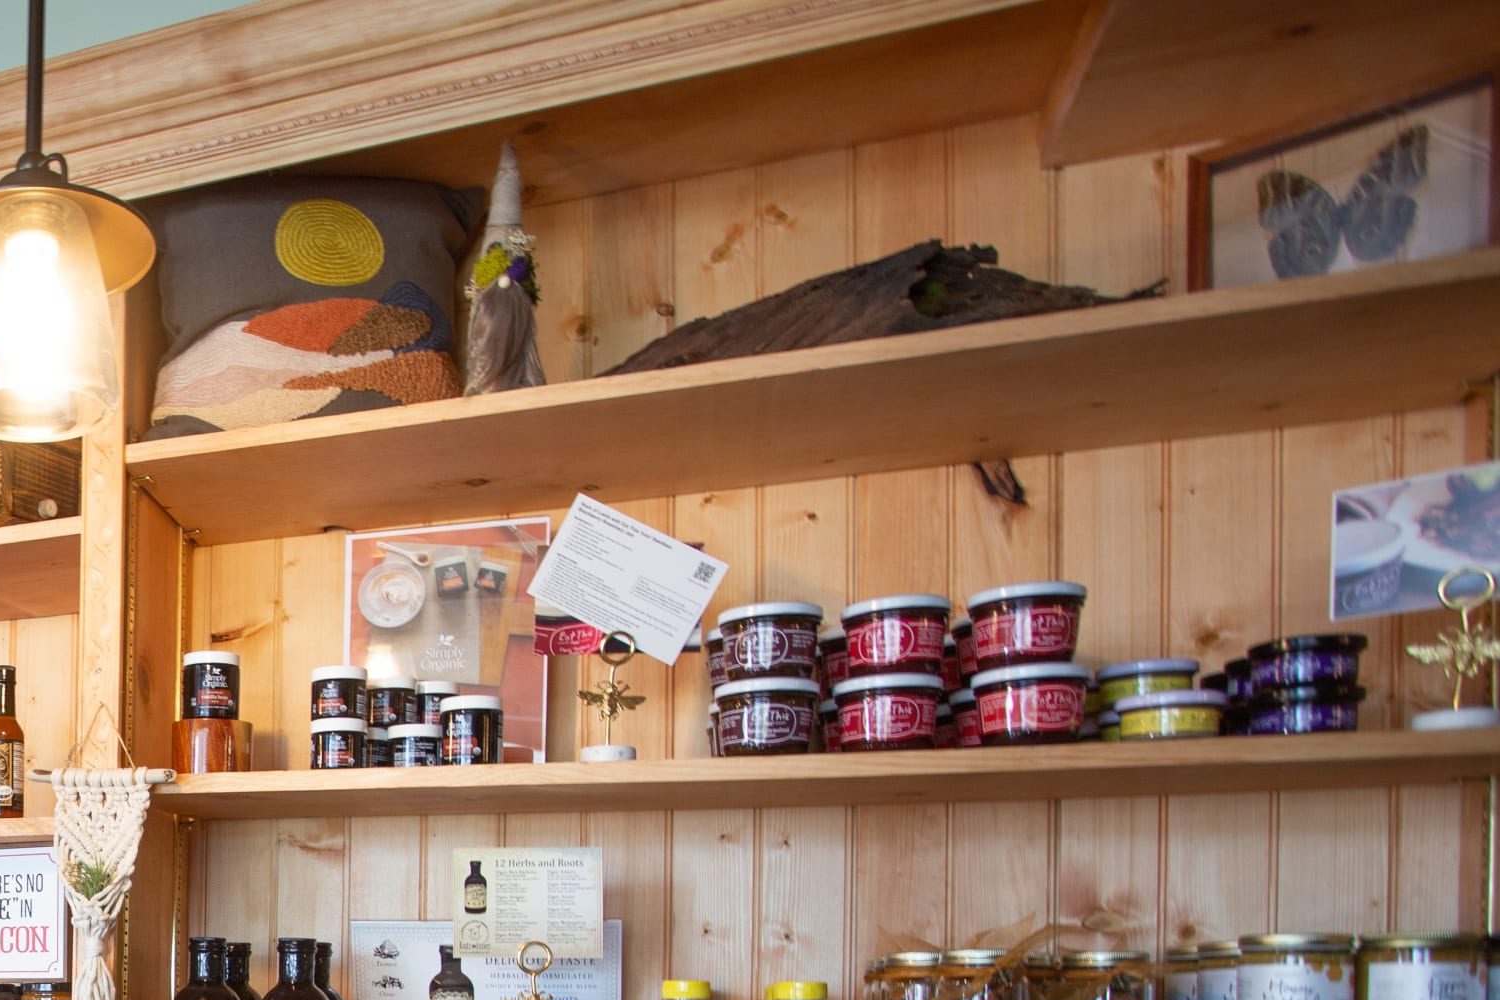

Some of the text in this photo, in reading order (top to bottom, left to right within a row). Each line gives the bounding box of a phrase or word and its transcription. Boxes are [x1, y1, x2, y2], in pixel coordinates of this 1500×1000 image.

[425, 646, 464, 660] Simply
[421, 659, 465, 671] Organic
[205, 674, 227, 682] Simply
[495, 859, 584, 868] 12 Herbs and Roots
[26, 873, 44, 893] NO
[20, 899, 32, 918] IN
